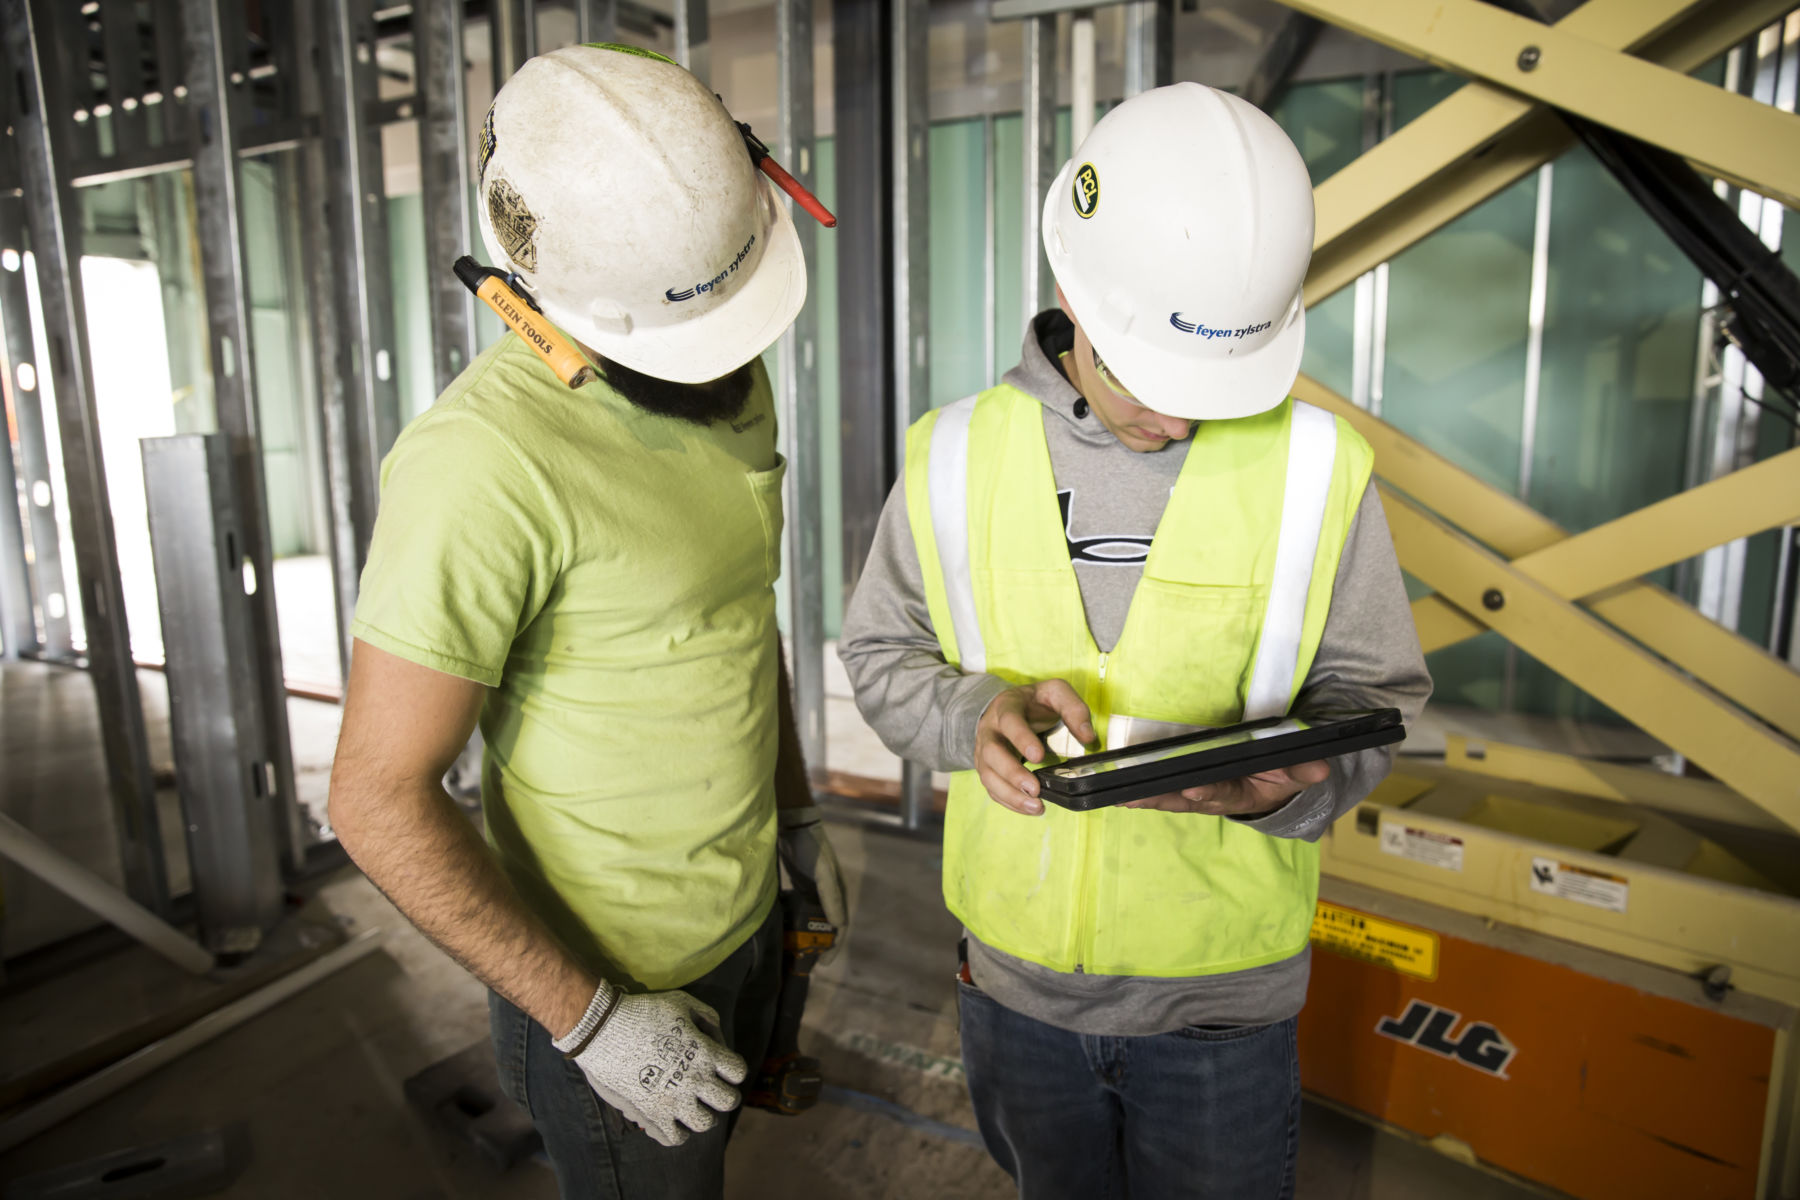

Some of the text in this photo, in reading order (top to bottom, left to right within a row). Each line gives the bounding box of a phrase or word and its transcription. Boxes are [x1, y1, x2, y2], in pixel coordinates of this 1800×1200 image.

[1080, 168, 1097, 204] PCL
[695, 234, 756, 295] feyen zylstra
[491, 291, 554, 354] KLEIN TOOLS
[1195, 320, 1272, 340] feyen zylstra
[1374, 998, 1518, 1076] JLG
[641, 1067, 656, 1085] A4
[665, 1039, 699, 1090] 4926L
